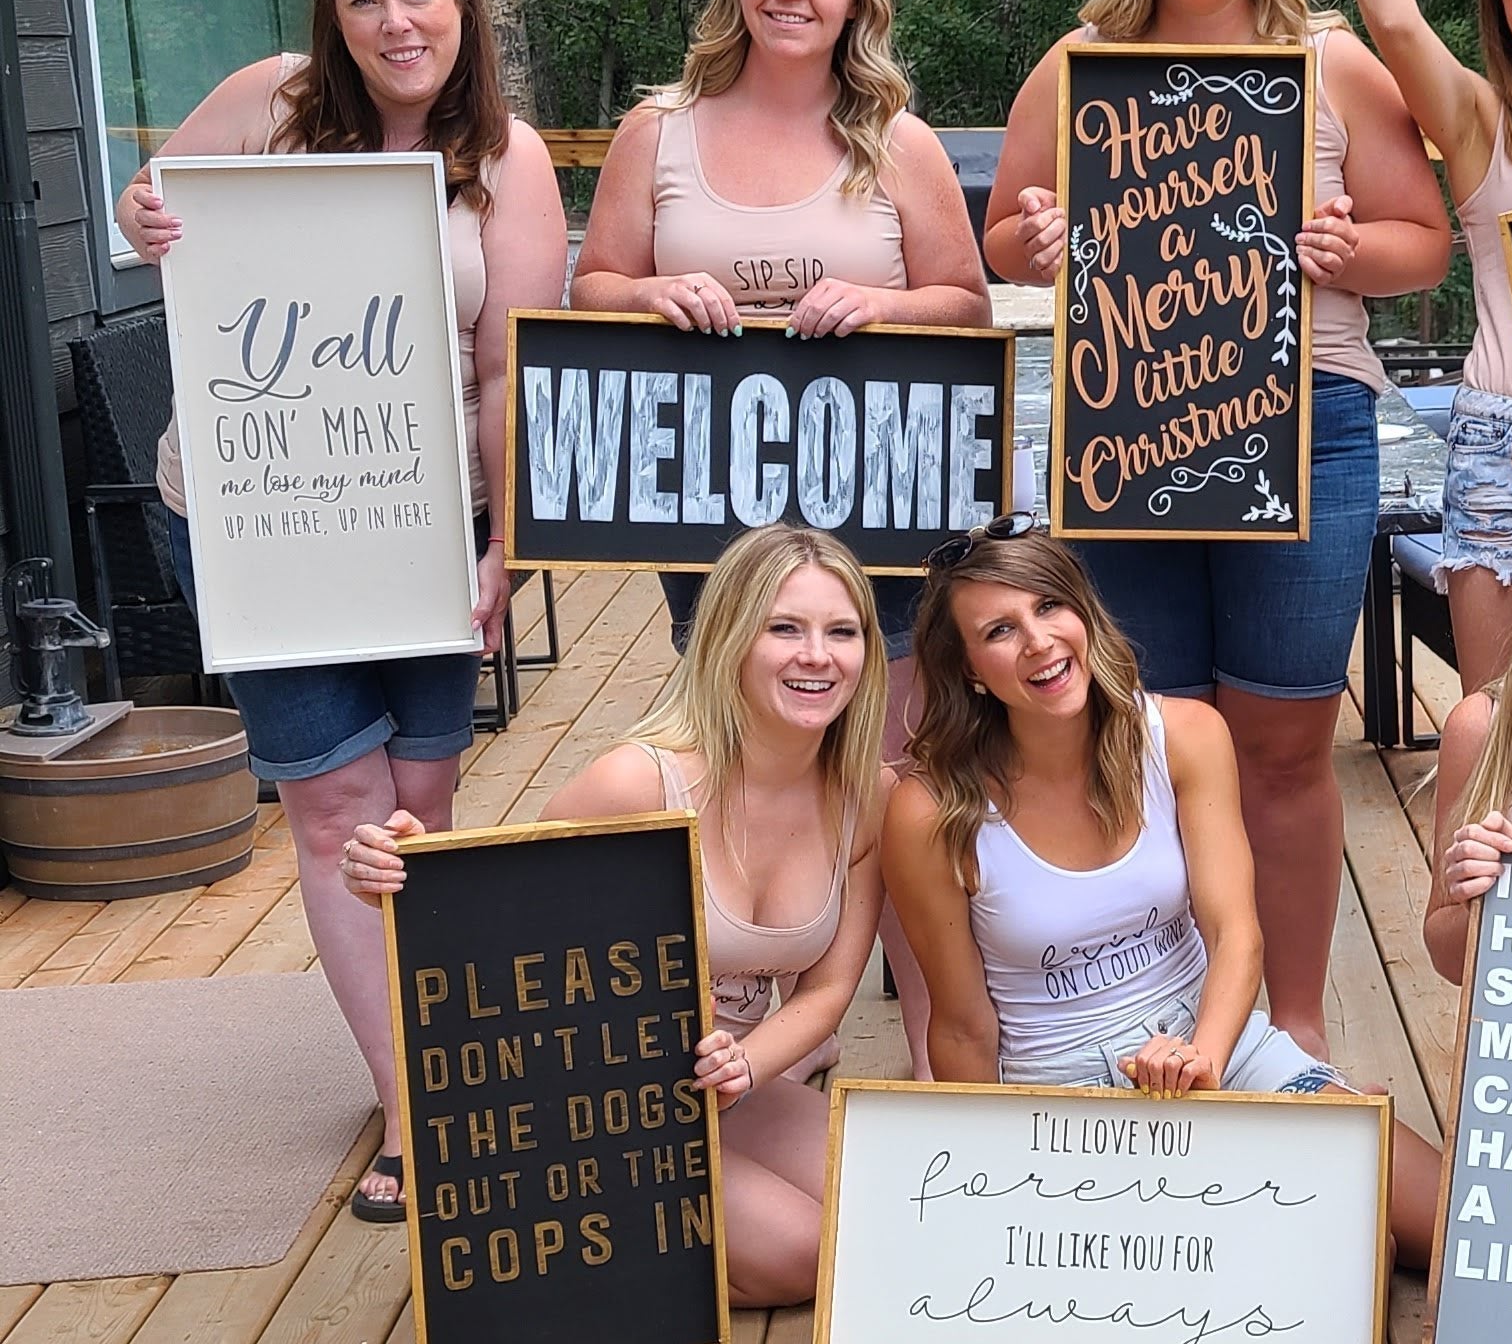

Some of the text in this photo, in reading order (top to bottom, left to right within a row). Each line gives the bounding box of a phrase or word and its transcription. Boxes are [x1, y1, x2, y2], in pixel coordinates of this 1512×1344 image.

[1074, 96, 1233, 180] Have
[1090, 134, 1279, 275] yourself
[1160, 222, 1196, 262] a
[734, 258, 823, 290] SIP SIP
[208, 294, 414, 403] Y'all
[1071, 247, 1275, 411] Merry
[1133, 333, 1244, 409] little
[215, 402, 423, 463] GON' MAKE
[522, 366, 996, 531] WELCOME
[1066, 370, 1295, 513] Christmas
[221, 456, 425, 503] me lose my mind
[224, 501, 433, 540] UP IN HERE, UP IN HERE
[1497, 863, 1512, 899] I
[415, 933, 691, 1026] PLEASE
[1045, 968, 1079, 999] ON
[1084, 942, 1151, 991] CLOUD
[422, 1009, 696, 1093] DON'T LET
[428, 1078, 701, 1164] THE DOGS
[1029, 1112, 1192, 1157] I'LL LOVE YOU
[436, 1139, 707, 1221] OUT OR THE
[910, 1151, 1317, 1223] forever
[1457, 1185, 1496, 1225] A
[441, 1194, 713, 1291] COPS IN
[1006, 1226, 1215, 1273] I'LL LIKE YOU FOR
